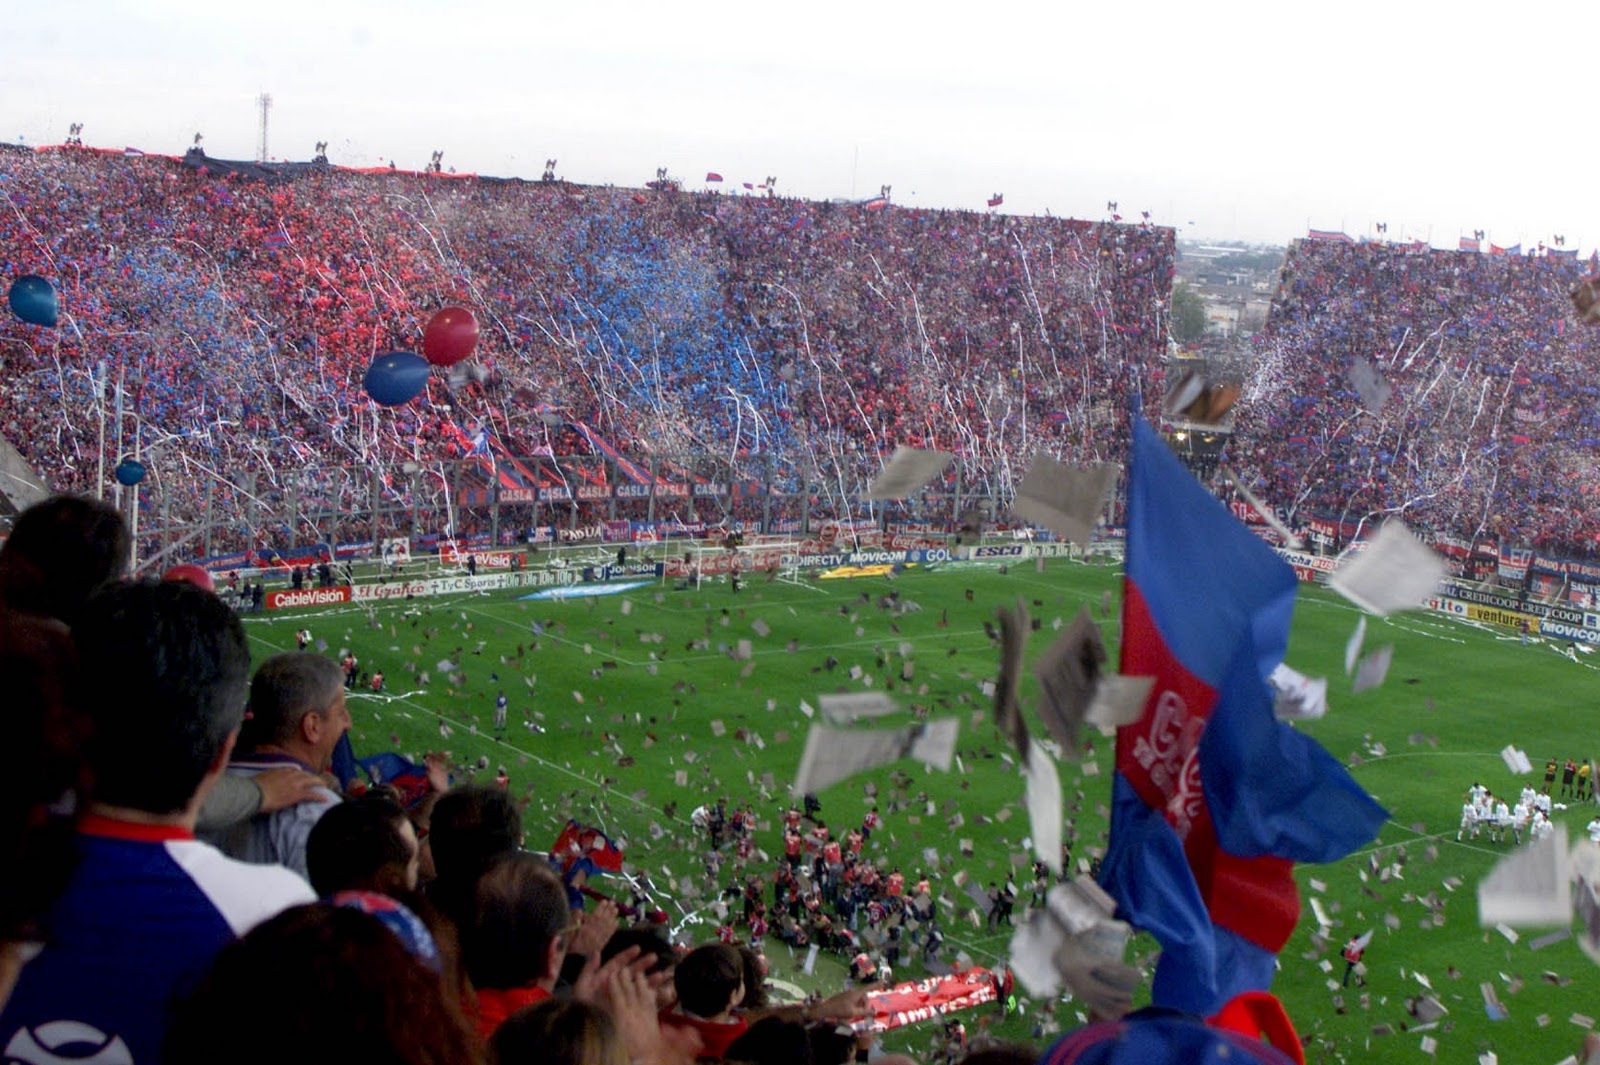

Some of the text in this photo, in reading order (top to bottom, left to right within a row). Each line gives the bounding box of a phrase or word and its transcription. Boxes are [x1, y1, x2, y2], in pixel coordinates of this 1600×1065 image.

[499, 489, 533, 502] CASLA
[849, 551, 906, 563] MOVICOM
[464, 577, 497, 591] Sports
[275, 589, 345, 608] CableVisión
[1460, 589, 1520, 610] CREDICOOP
[1477, 608, 1522, 627] ventura
